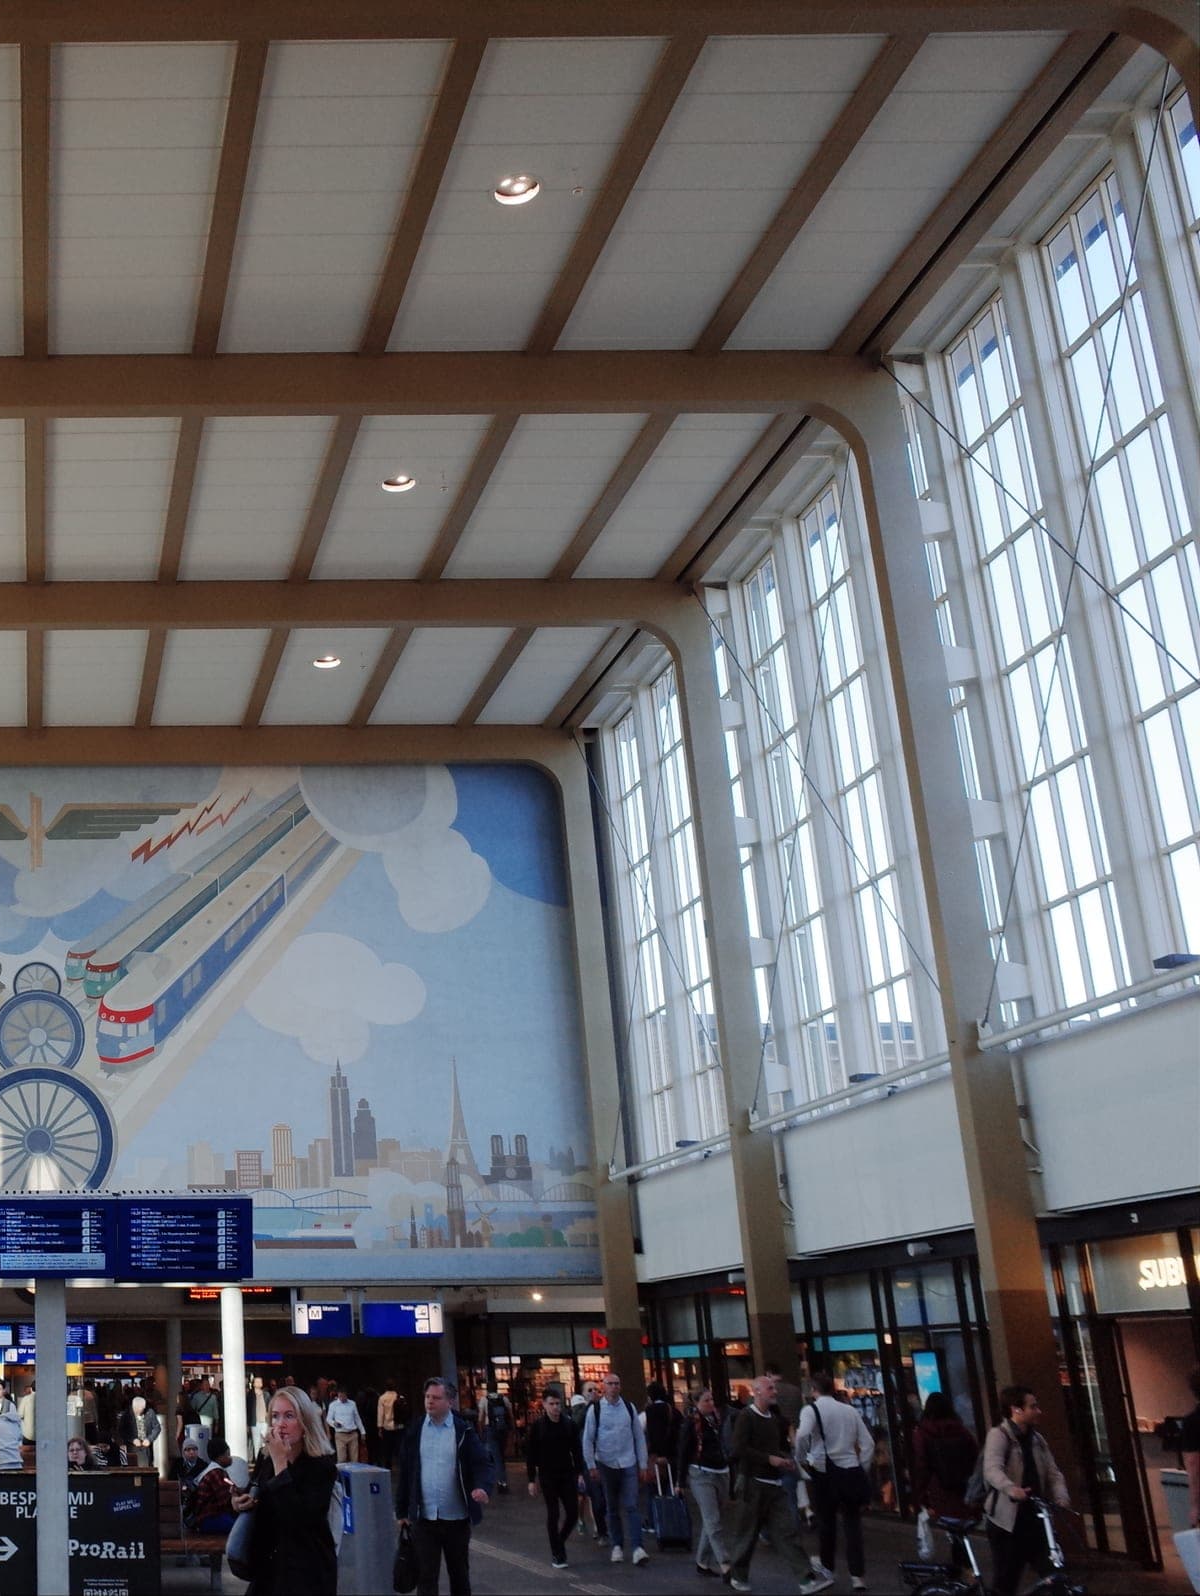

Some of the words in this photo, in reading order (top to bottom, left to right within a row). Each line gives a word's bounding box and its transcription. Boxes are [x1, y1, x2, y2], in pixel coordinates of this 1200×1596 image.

[1139, 1256, 1188, 1290] SUB
[0, 1492, 37, 1505] BESP
[68, 1539, 146, 1559] ProRail
